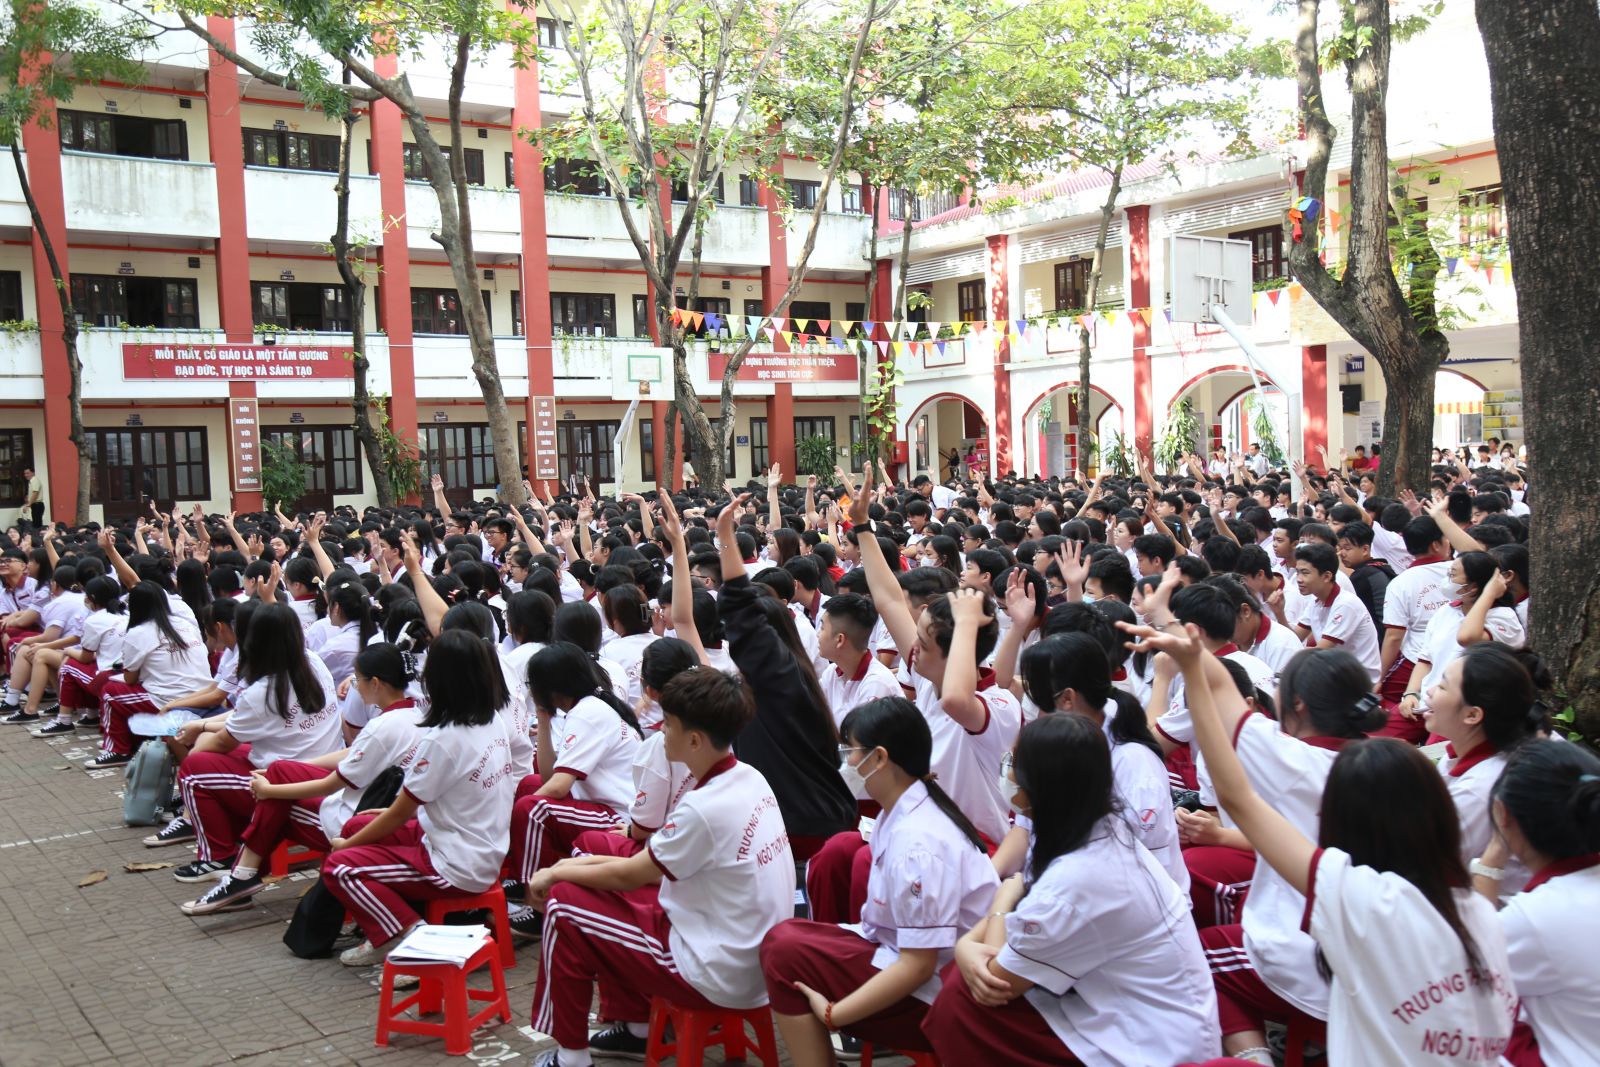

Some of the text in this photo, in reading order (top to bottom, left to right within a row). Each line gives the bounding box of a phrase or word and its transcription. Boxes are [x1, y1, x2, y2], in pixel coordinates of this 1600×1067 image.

[219, 348, 241, 360] GIÁO
[242, 348, 254, 360] LÀ
[256, 348, 275, 362] MỘT
[277, 348, 297, 360] TẤM
[299, 350, 329, 361] GƯƠNG
[175, 364, 313, 377] ĐẠO ĐỨC, TỰ HỌC VÀ SÁNG TẠO
[299, 717, 315, 731] NGÔ
[737, 813, 759, 862] TRƯỜNG
[756, 843, 773, 867] NGÔ
[1392, 973, 1465, 1025] TRƯỜNG
[1421, 1028, 1463, 1057] NGÔ
